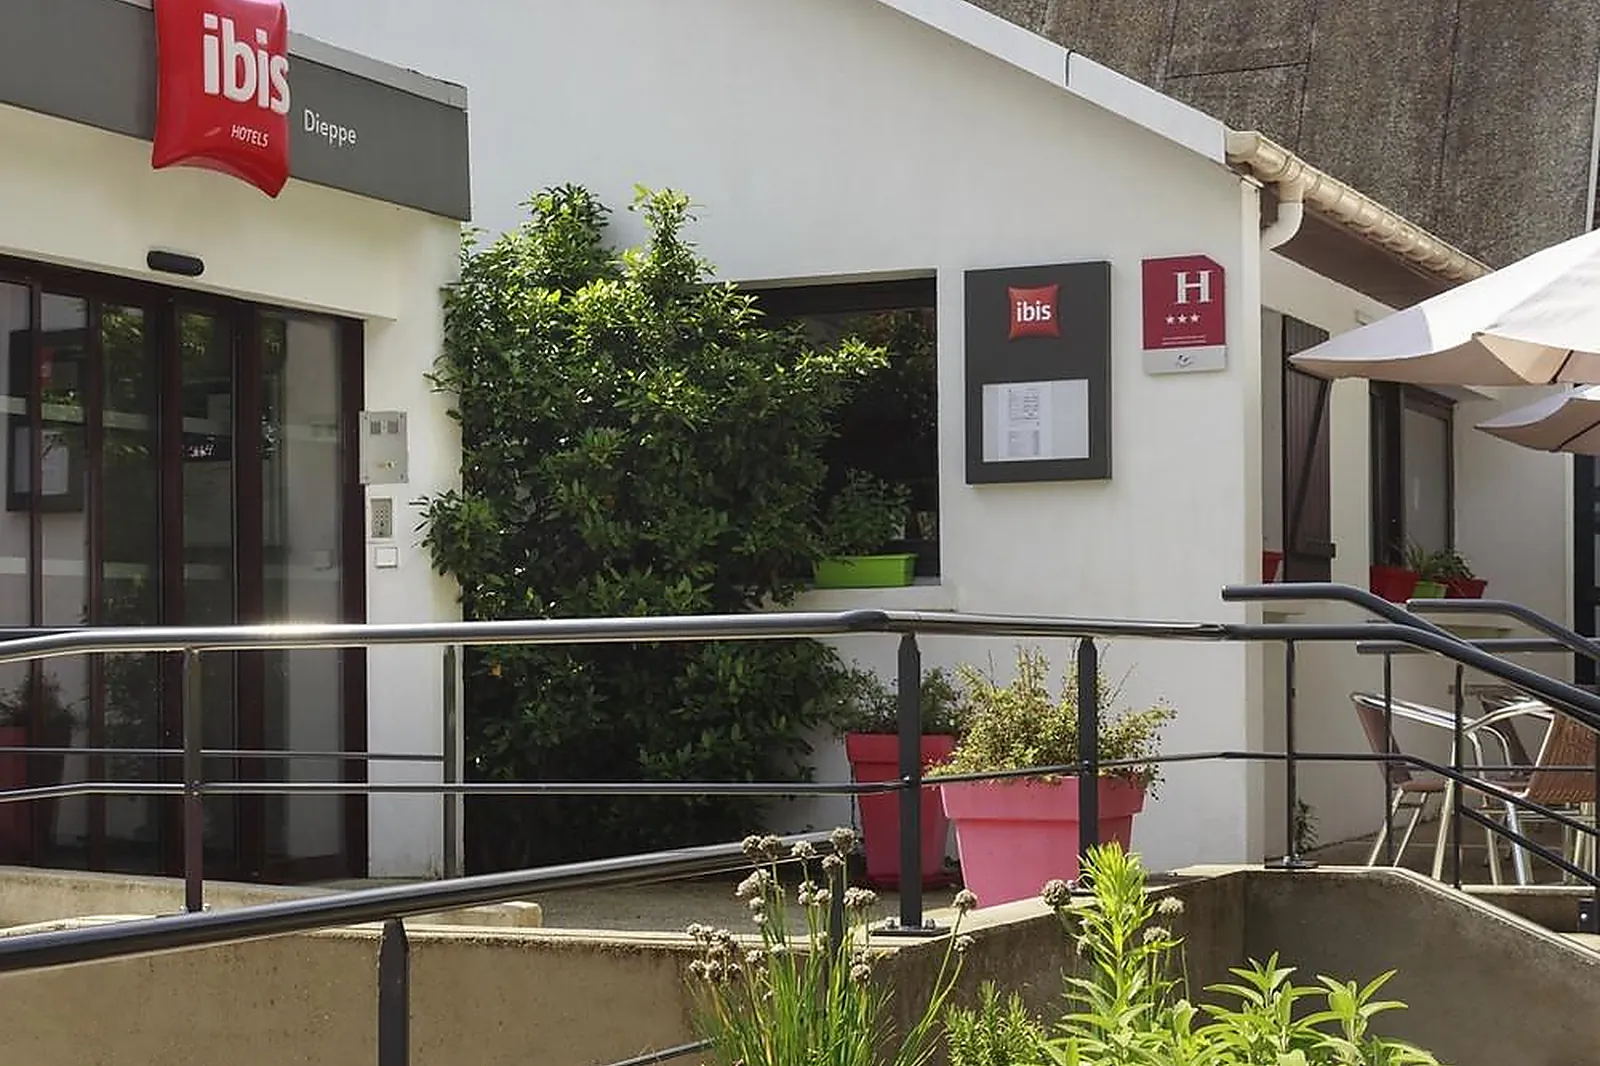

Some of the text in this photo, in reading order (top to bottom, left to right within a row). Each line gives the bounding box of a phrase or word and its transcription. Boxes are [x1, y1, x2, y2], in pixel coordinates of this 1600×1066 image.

[203, 13, 291, 115] ibis
[230, 124, 269, 147] HOTELS
[303, 108, 357, 147] Dieppe
[1173, 269, 1213, 304] H
[1016, 300, 1051, 322] ibis
